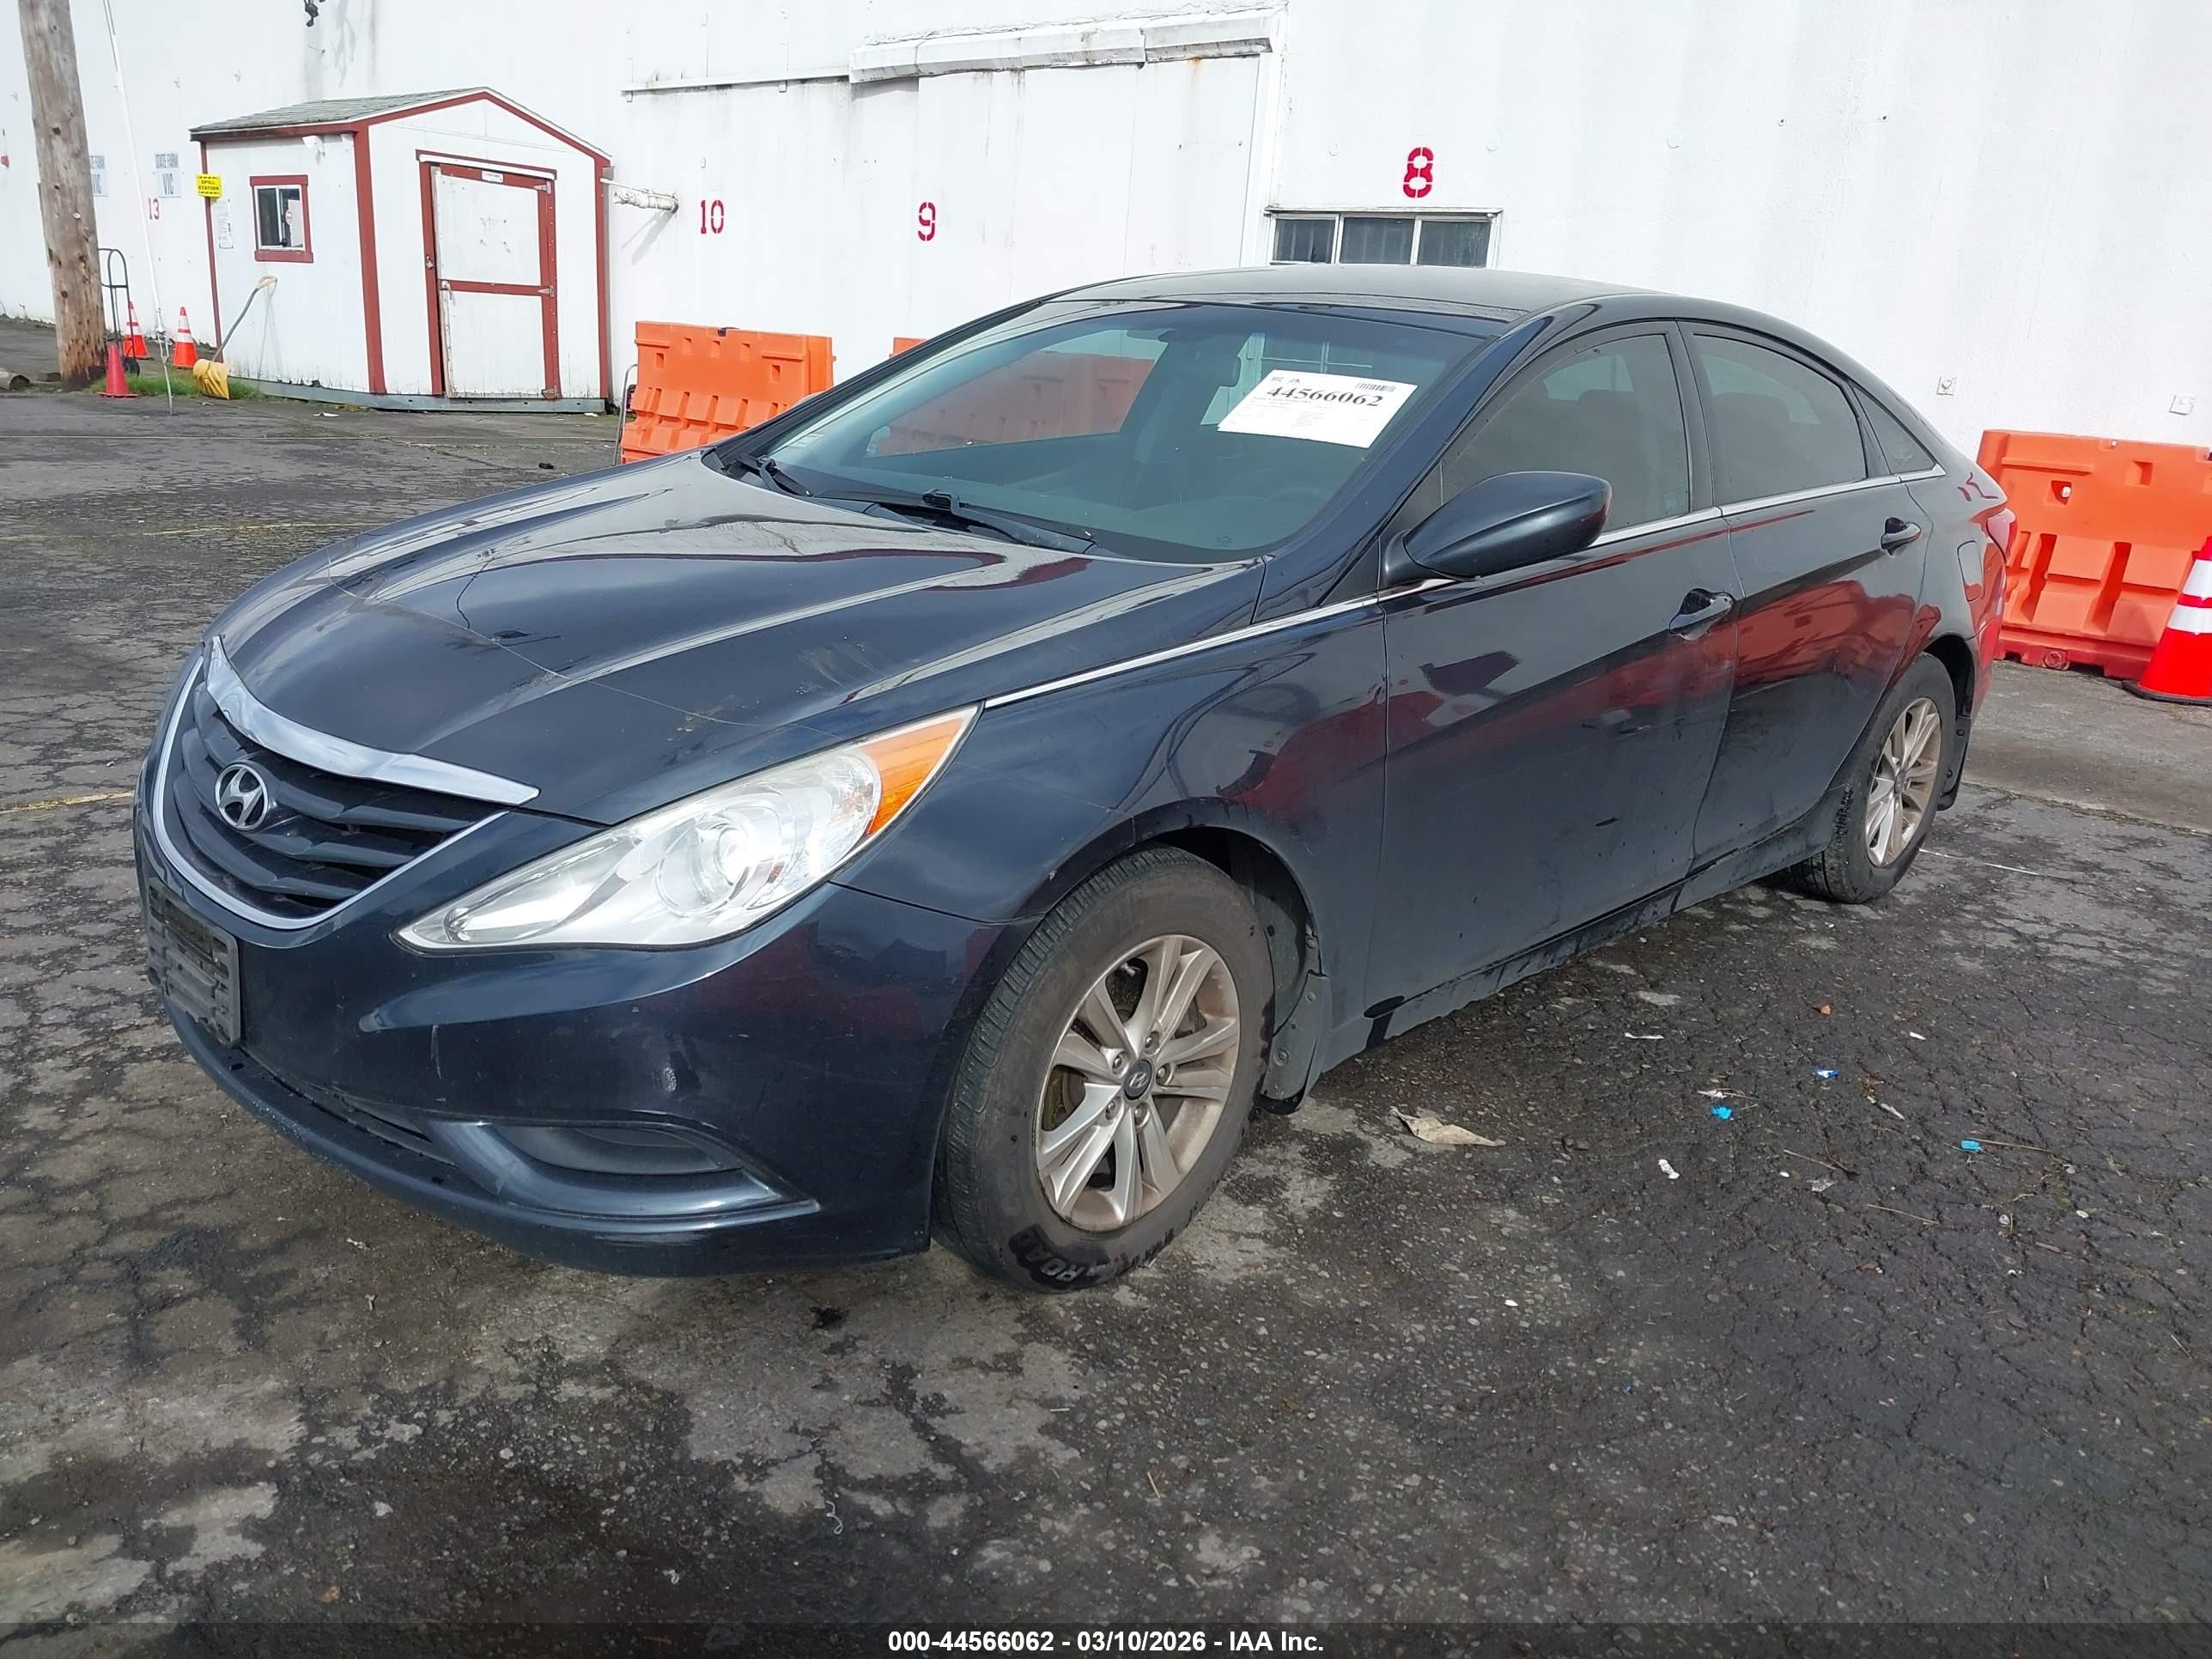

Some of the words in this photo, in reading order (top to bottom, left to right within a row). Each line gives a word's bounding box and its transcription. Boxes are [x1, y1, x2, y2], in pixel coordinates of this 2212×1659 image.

[162, 173, 173, 195] VIC
[1402, 147, 1434, 198] 8
[149, 198, 160, 220] 13
[700, 199, 725, 234] 10
[917, 202, 936, 241] 9
[1266, 386, 1384, 407] 44566062
